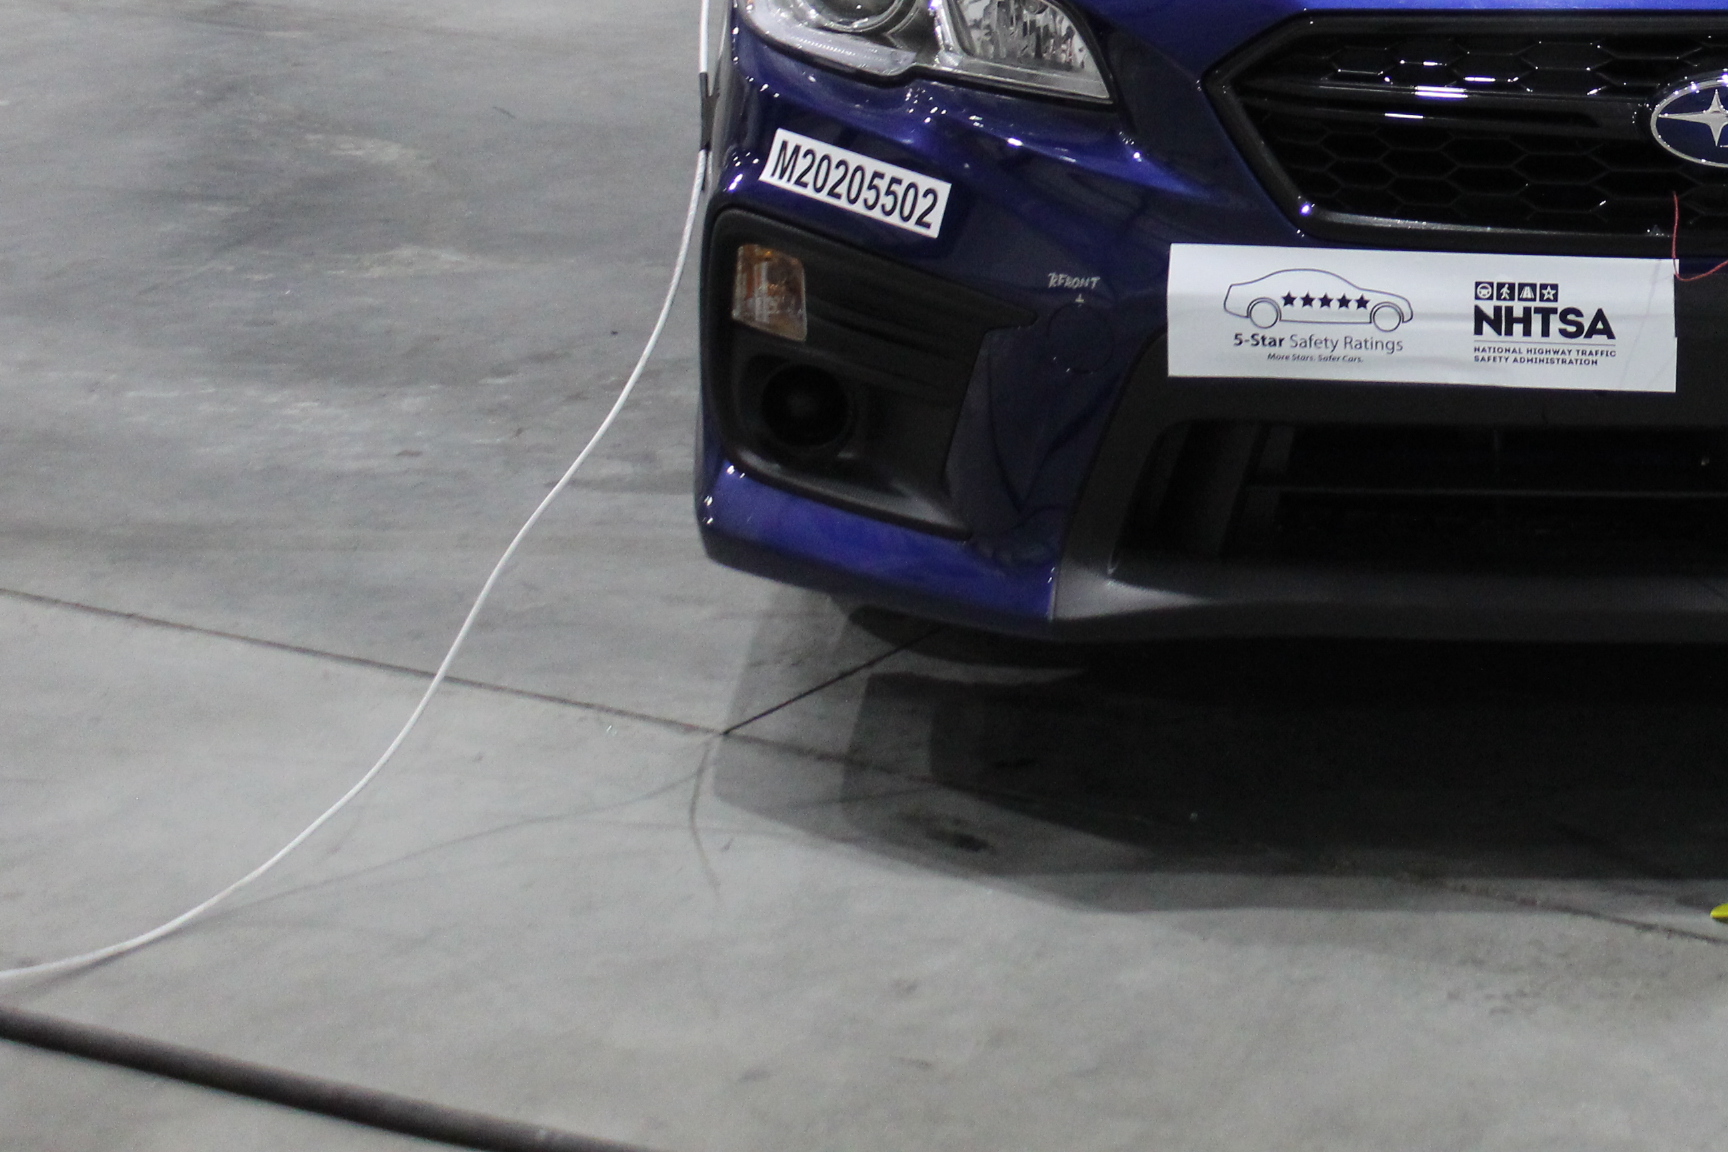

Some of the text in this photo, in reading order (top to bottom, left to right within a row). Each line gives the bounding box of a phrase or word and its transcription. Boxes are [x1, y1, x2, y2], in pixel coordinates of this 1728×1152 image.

[771, 140, 938, 229] M20205502
[1473, 305, 1616, 340] NHTSA
[1233, 333, 1404, 355] 5-Star Safety Ratings
[1474, 346, 1616, 358] NATIONAL HIGHWAY TRAFFIC
[1267, 353, 1290, 361] More
[1474, 355, 1599, 366] SAFETY ADMINISTRATION
